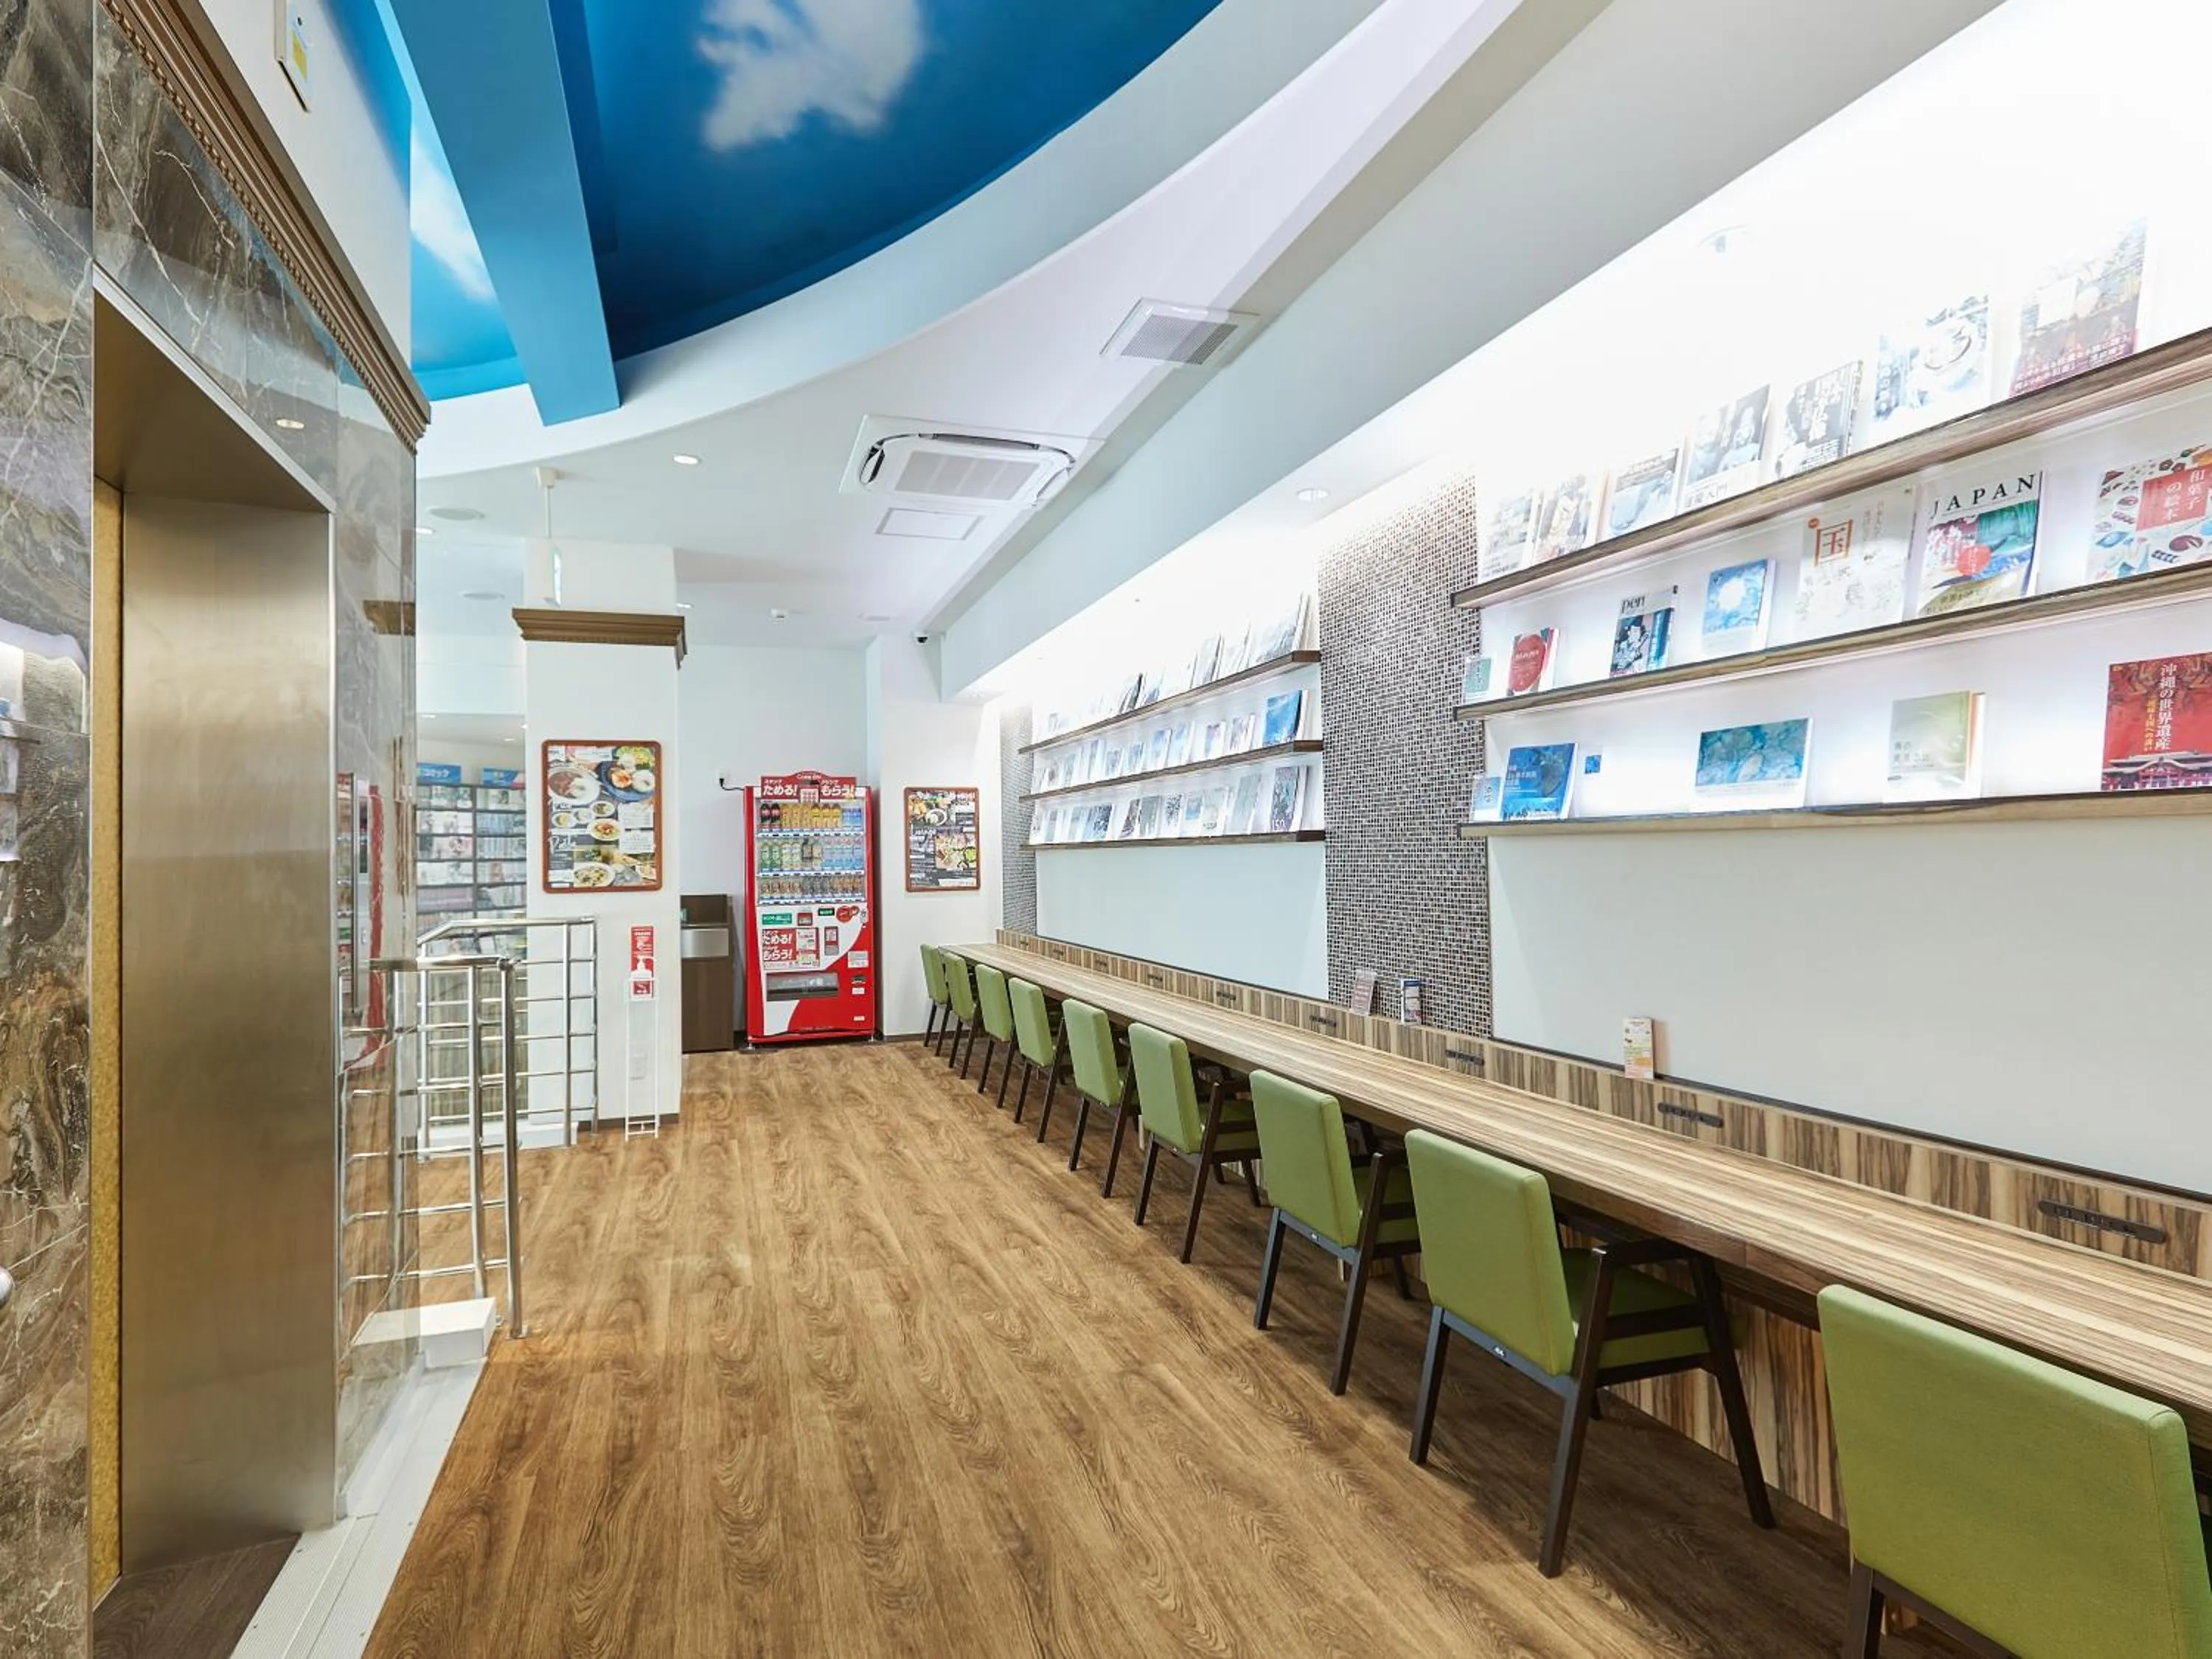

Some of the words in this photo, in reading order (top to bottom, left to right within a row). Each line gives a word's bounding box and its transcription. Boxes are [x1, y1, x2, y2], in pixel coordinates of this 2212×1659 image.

[1930, 473, 2037, 521] JAPAN
[1621, 595, 1646, 614] pen
[2154, 664, 2177, 751] 沖縄の世界遺産
[762, 784, 797, 796] ためる!
[821, 784, 855, 796] もらう!
